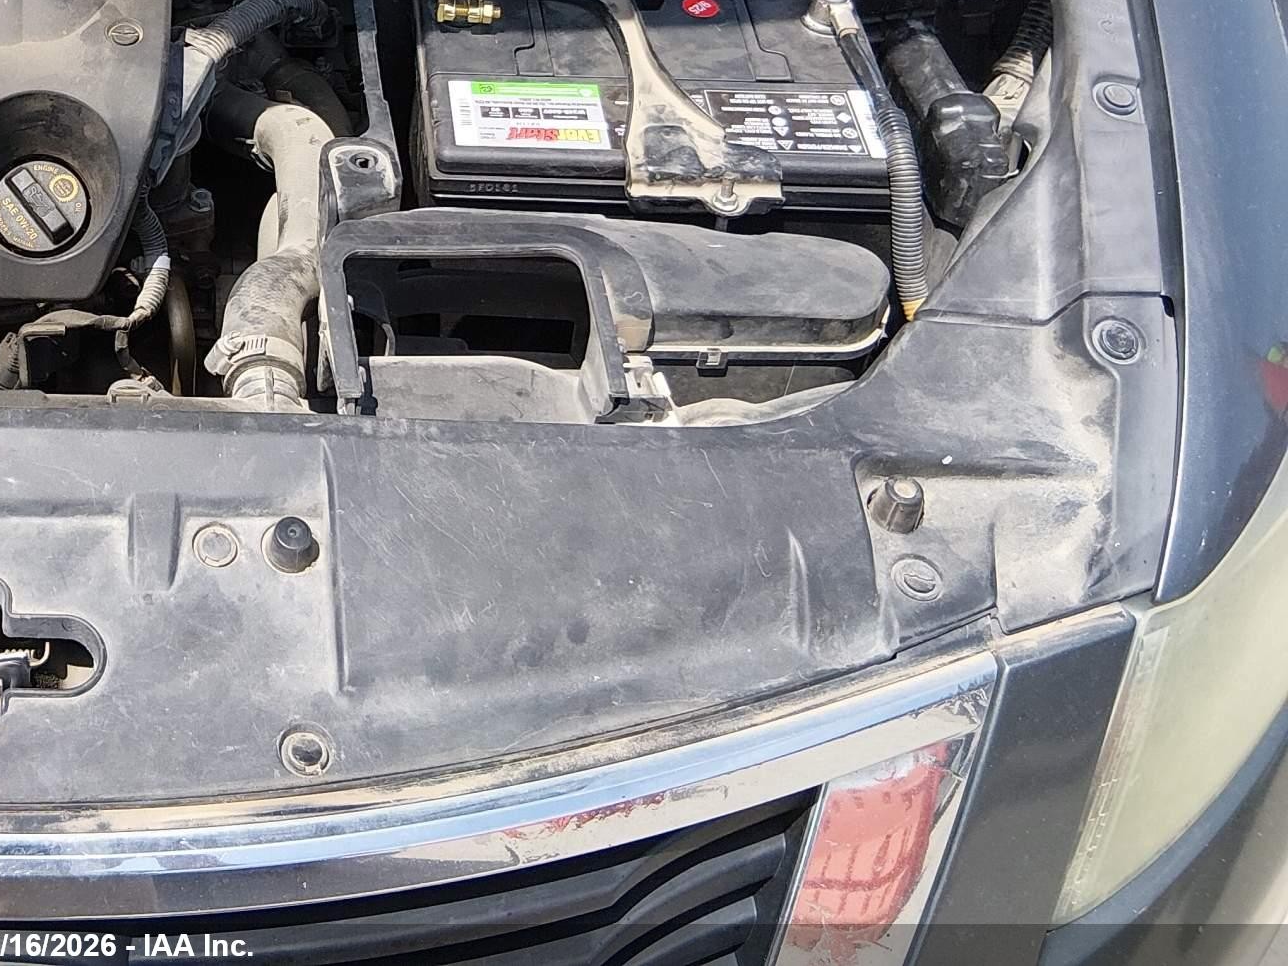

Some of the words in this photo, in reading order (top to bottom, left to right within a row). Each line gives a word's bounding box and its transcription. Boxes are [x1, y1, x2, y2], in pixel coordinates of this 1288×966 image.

[33, 164, 59, 174] ENGINE
[2, 197, 20, 216] SAE
[15, 213, 38, 240] 0W-20
